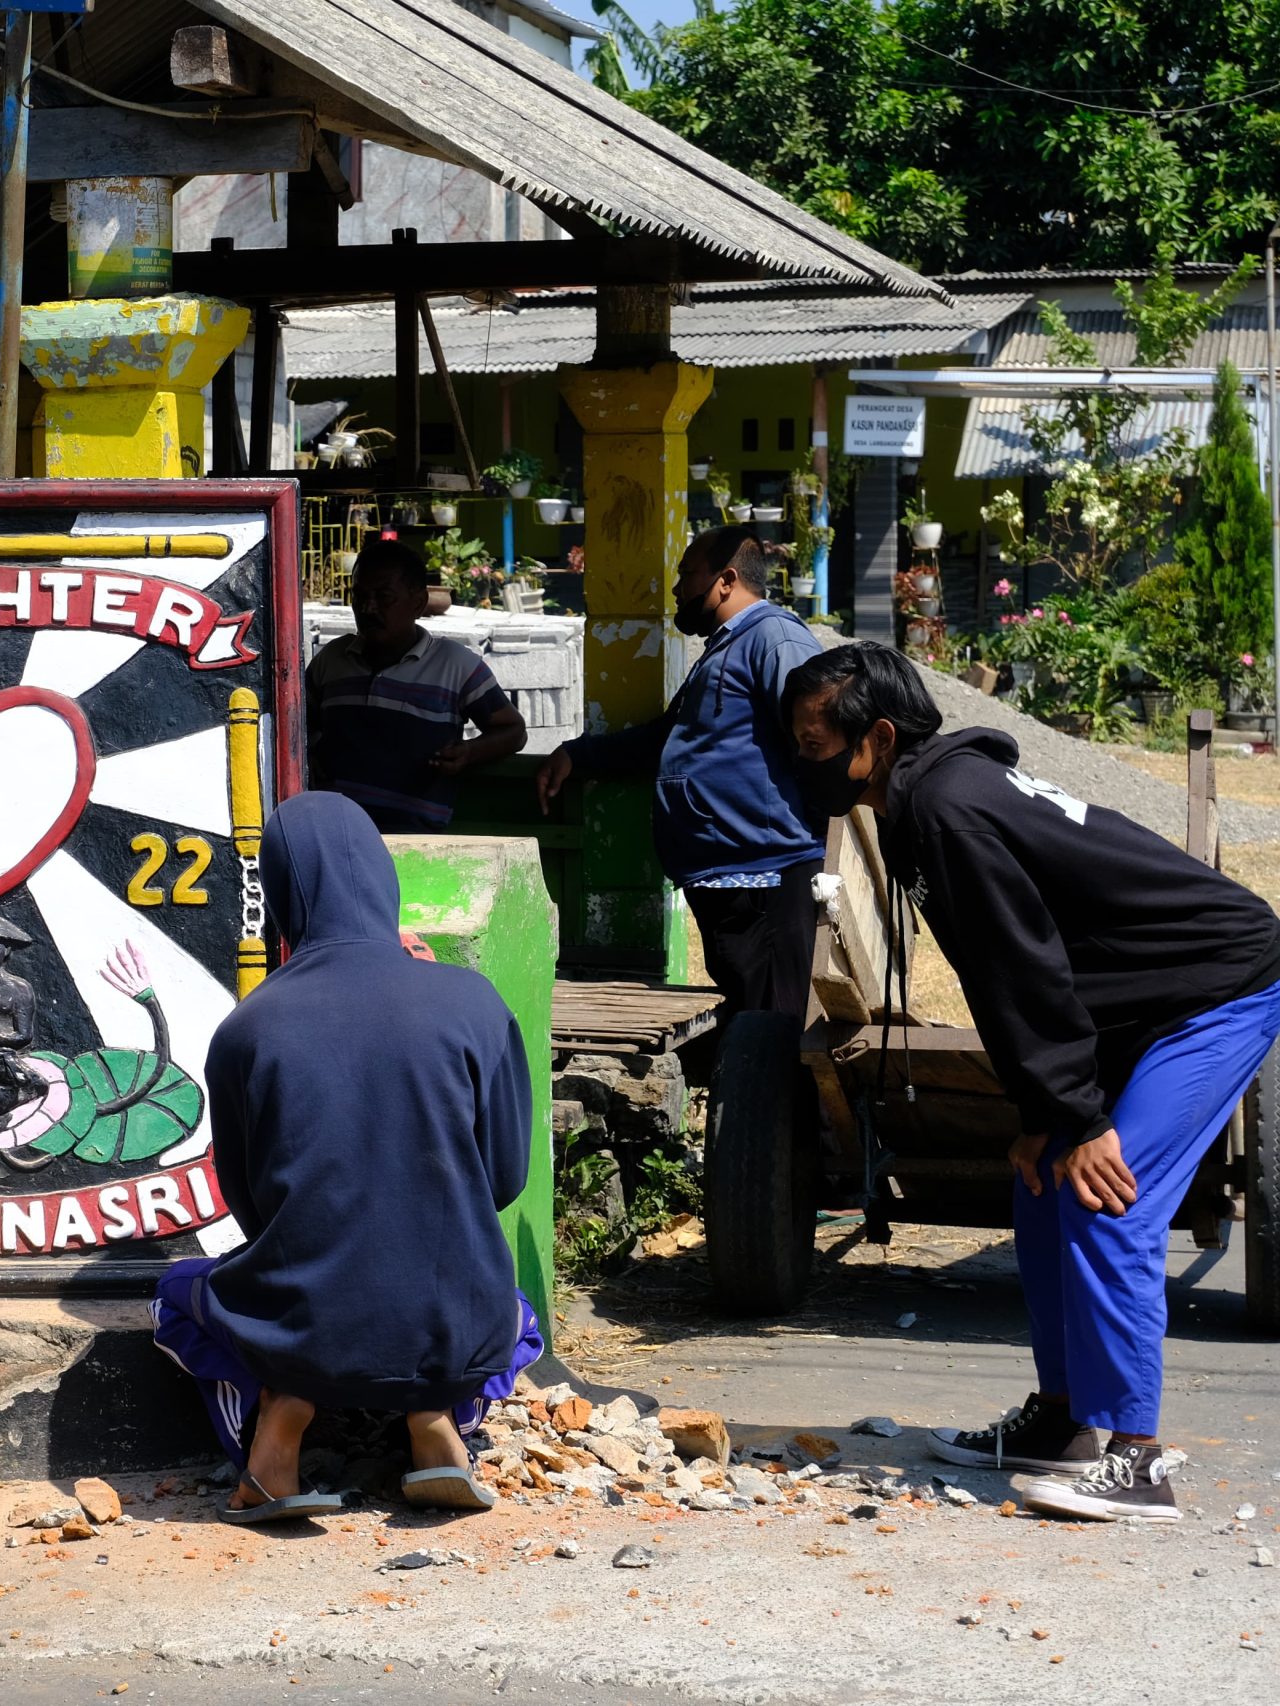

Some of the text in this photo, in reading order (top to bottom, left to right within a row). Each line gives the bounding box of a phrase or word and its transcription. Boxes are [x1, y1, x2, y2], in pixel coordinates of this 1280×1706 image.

[857, 404, 894, 412] PERANGKAT
[851, 420, 874, 431] KASUN
[126, 832, 214, 906] 22
